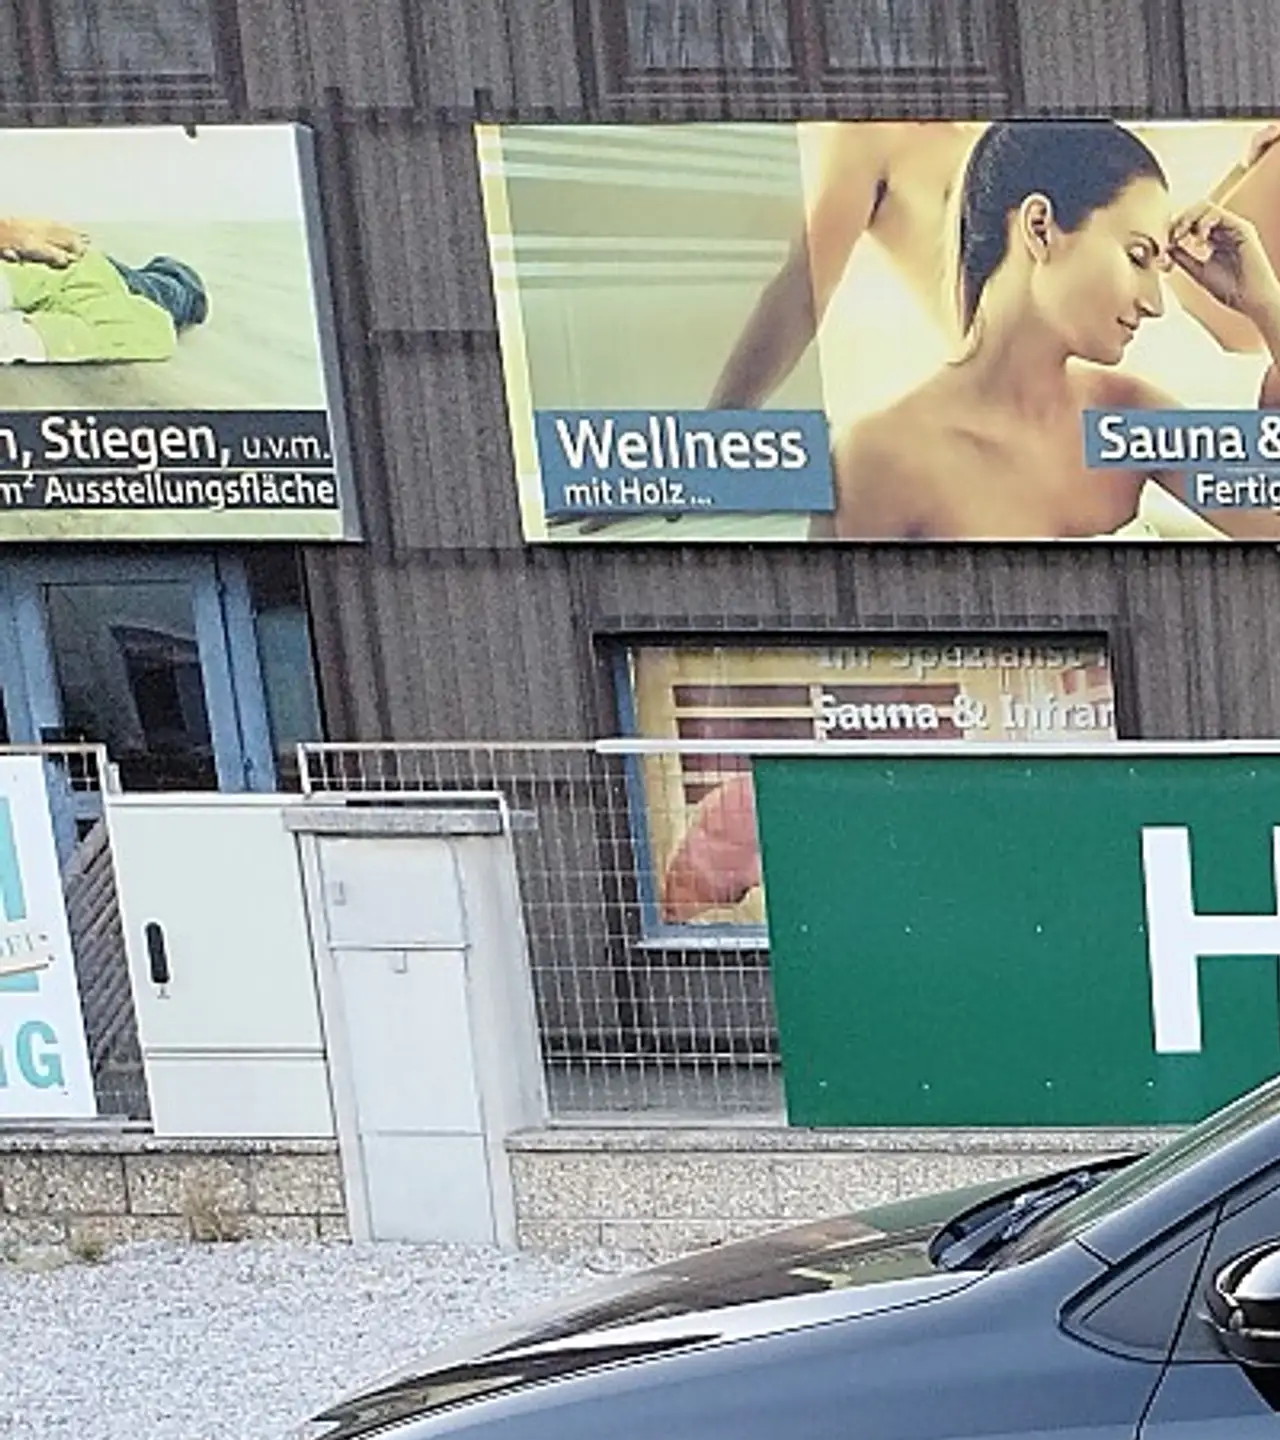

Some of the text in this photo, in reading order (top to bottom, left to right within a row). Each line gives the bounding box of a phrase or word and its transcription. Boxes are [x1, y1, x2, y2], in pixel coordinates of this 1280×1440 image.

[41, 416, 231, 471] Stiegen,
[242, 433, 331, 460] u.v.m.
[555, 416, 809, 470] Wellness
[1098, 416, 1247, 461] Sauna
[45, 472, 335, 512] Ausstellungsfläche
[564, 477, 614, 506] mit
[817, 693, 939, 730] Sauna
[952, 693, 988, 730] &
